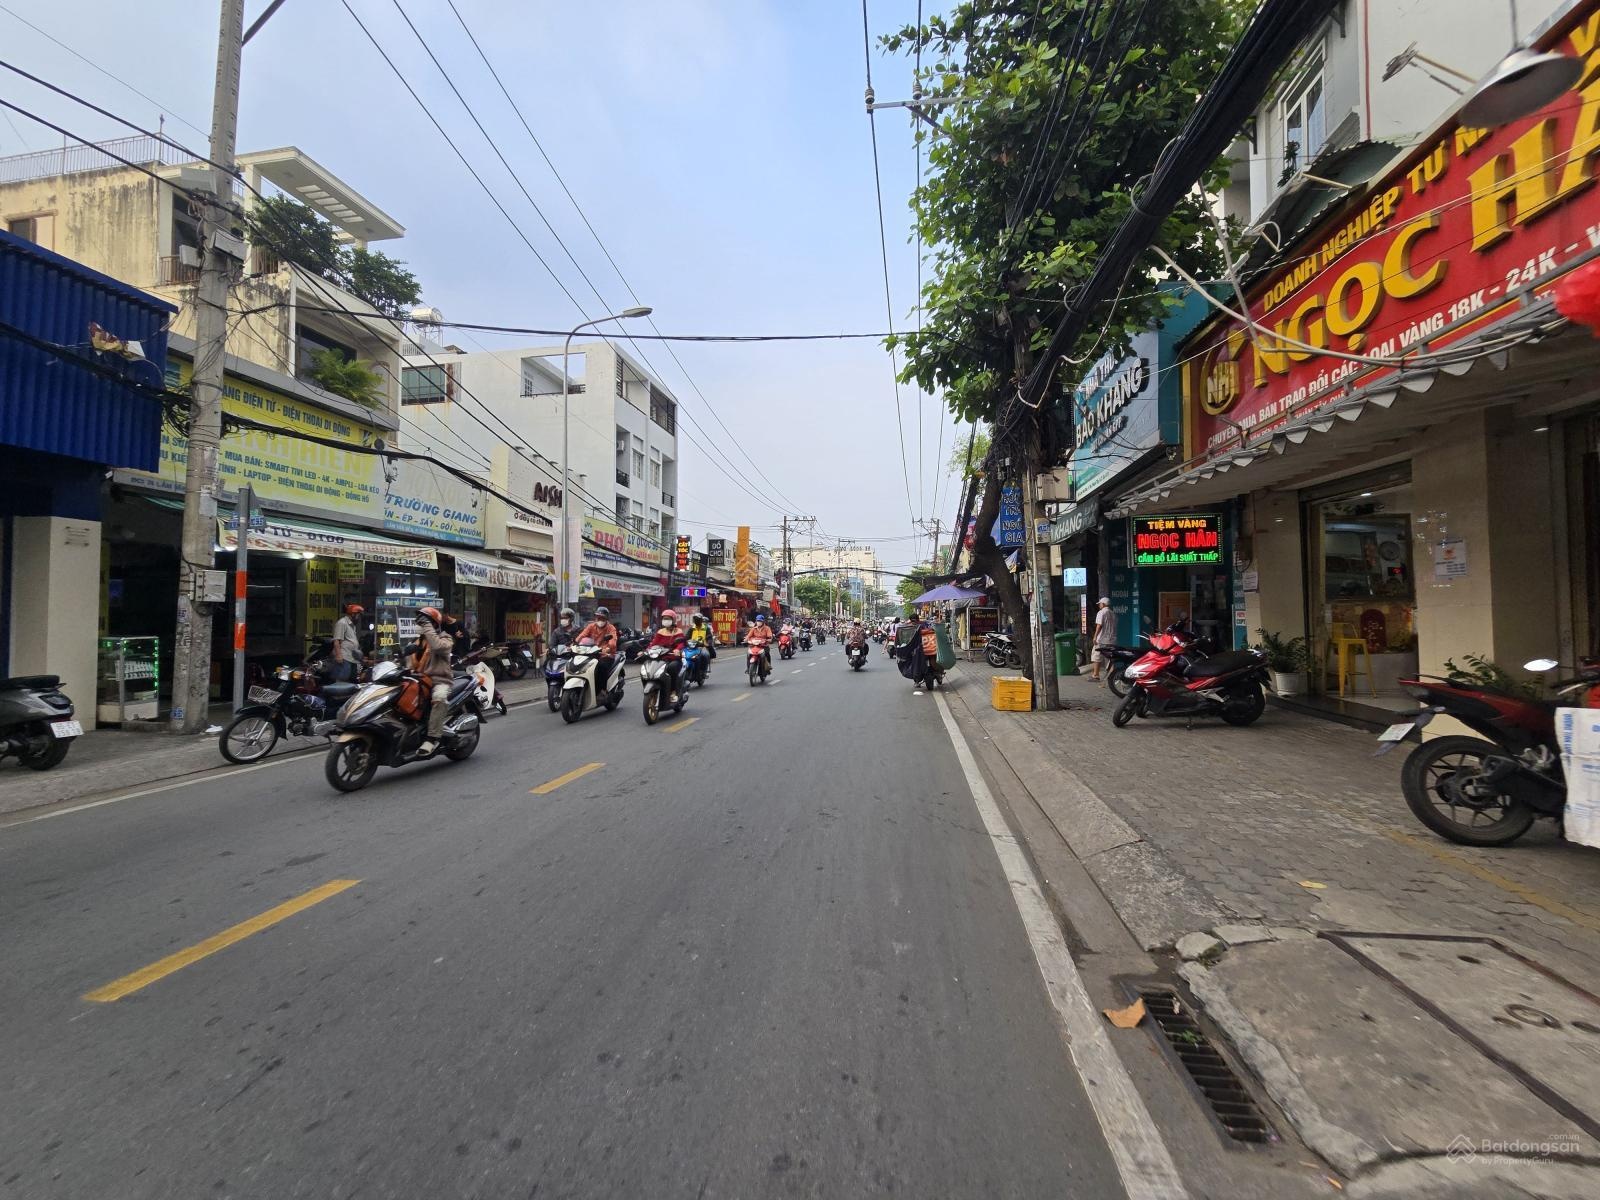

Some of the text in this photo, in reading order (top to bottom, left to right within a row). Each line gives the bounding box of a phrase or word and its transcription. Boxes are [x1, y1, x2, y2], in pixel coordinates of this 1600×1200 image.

[1263, 253, 1318, 312] DOANH
[1321, 186, 1403, 266] NGHIỆP
[1407, 139, 1447, 195] TƯ
[1251, 210, 1450, 389] NGỌC
[1207, 424, 1237, 449] CHUYÊN
[1238, 413, 1258, 432] MUA
[1259, 401, 1278, 422] BÁN
[1279, 386, 1307, 412] TRAO
[1309, 369, 1329, 397] ĐỔI
[1331, 359, 1359, 385] CÁC
[1399, 312, 1444, 348] VÀNG
[1447, 288, 1485, 323] 18K
[1505, 246, 1557, 294] 24K
[1097, 357, 1143, 428] KHANG
[243, 388, 264, 409] ĐIỆN
[265, 395, 276, 413] TỬ
[282, 404, 301, 421] ĐIỆN
[302, 410, 323, 430] THOẠI
[323, 418, 333, 431] DI
[332, 418, 351, 438] ĐỘNG
[225, 451, 243, 464] MUA
[265, 460, 290, 476] SMART
[291, 465, 304, 478] TIVI
[304, 468, 317, 481] LED
[321, 472, 330, 484] 4K
[357, 481, 368, 493] LOA
[244, 468, 272, 484] LAPTOP
[278, 475, 295, 490] ĐIỆN
[296, 481, 315, 494] THOẠI
[315, 485, 324, 494] DI
[323, 485, 341, 500] ĐỘNG
[386, 493, 478, 525] TRƯỜNG GIANG
[420, 515, 434, 528] SẤY
[1147, 518, 1207, 531] TIỆM VÀNG
[1054, 511, 1083, 540] KHANG
[1137, 529, 1218, 552] NGỌC HÂN
[373, 553, 396, 565] 0918
[415, 560, 431, 569] 987
[1154, 551, 1166, 563] ĐỒ
[1166, 552, 1179, 562] LÃI
[1179, 552, 1198, 562] SUẤT
[1199, 550, 1219, 561] THẤP
